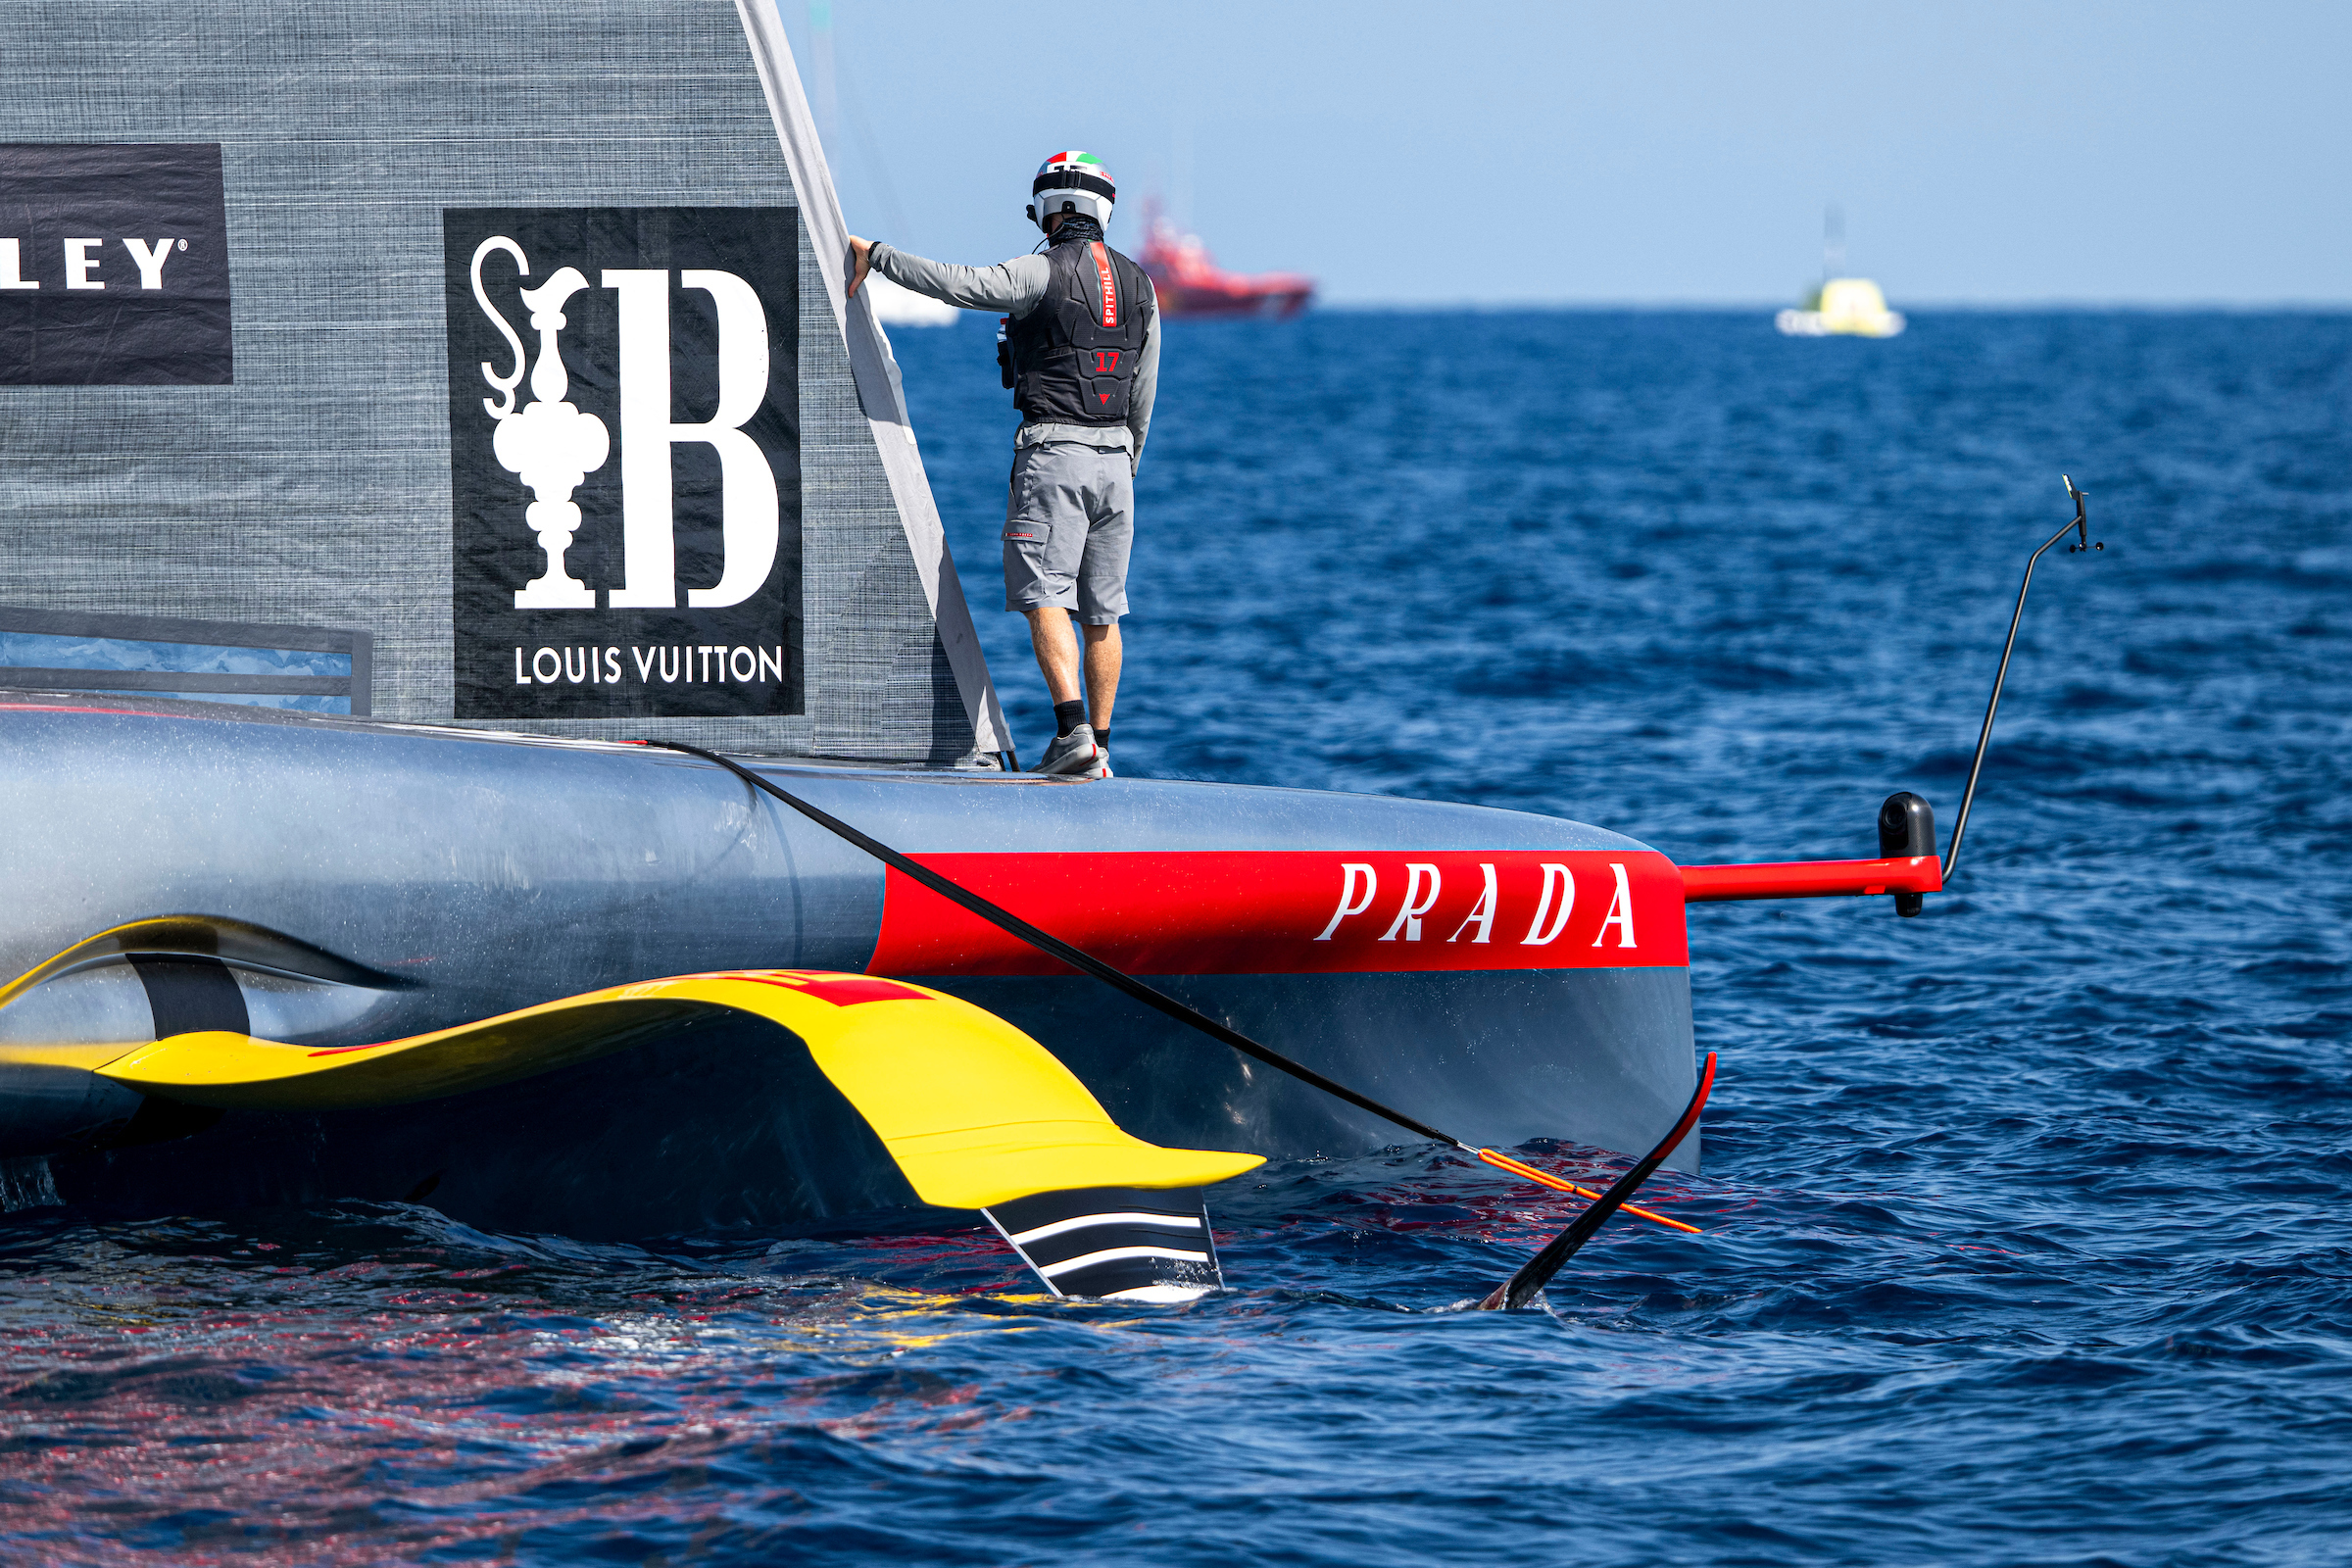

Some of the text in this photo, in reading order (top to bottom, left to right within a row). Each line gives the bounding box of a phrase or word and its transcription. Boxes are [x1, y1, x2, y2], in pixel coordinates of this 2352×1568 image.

[1101, 267, 1114, 323] SPITHILL
[1095, 351, 1120, 372] 17
[514, 645, 783, 684] LOUIS VUITTON
[1312, 862, 1639, 949] PRADA
